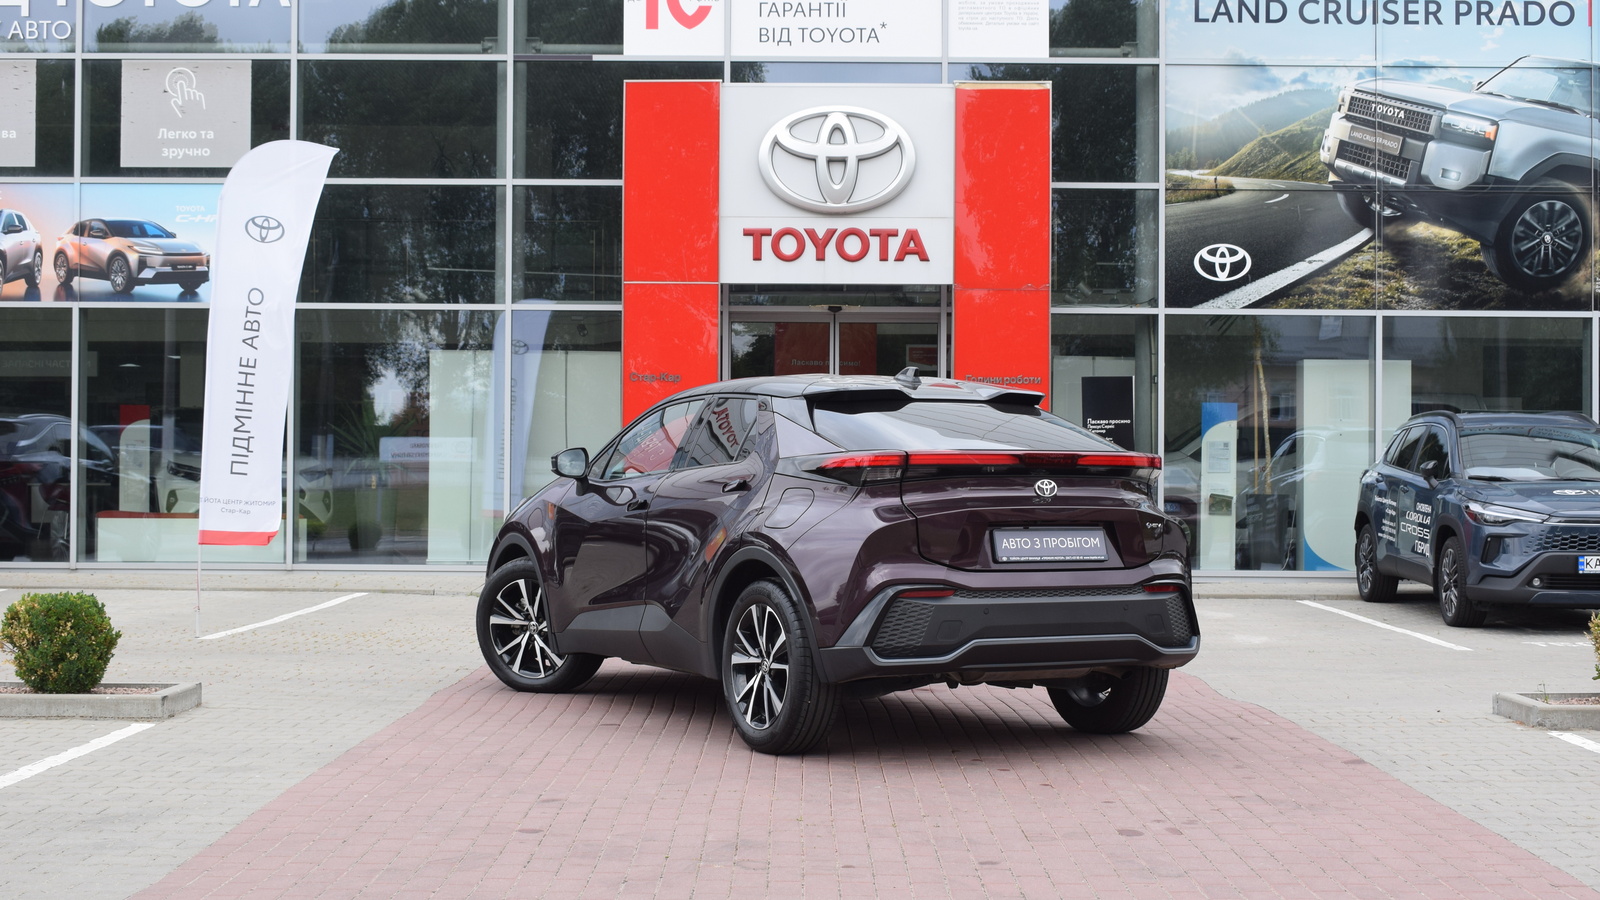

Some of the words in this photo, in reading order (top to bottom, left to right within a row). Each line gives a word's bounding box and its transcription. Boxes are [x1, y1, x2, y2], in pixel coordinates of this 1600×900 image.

[1193, 0, 1288, 24] LAND
[1298, 0, 1443, 25] CRUISER
[1454, 0, 1576, 26] PRADO
[7, 20, 72, 40] АВТО
[759, 27, 792, 46] ВІД
[1371, 104, 1405, 119] TOYOTA
[157, 128, 197, 140] Легко
[199, 130, 214, 139] та
[1350, 130, 1362, 140] LAND
[1382, 137, 1398, 149] PRADO
[161, 147, 211, 159] зручно
[743, 226, 930, 262] TOYOTA
[242, 287, 264, 350] АВТО
[791, 359, 824, 367] Ласкаво
[629, 372, 681, 384] Стар-Кар
[1004, 375, 1041, 386] роботи
[230, 357, 257, 476] ПІДМІННЕ
[222, 498, 243, 506] ЦЕНТР
[220, 507, 251, 515] Стар-Кар
[1406, 510, 1431, 525] COROLLA
[1400, 521, 1430, 540] CROSS
[1002, 538, 1031, 549] АВТО
[1043, 537, 1100, 549] ПРОБІГОМ
